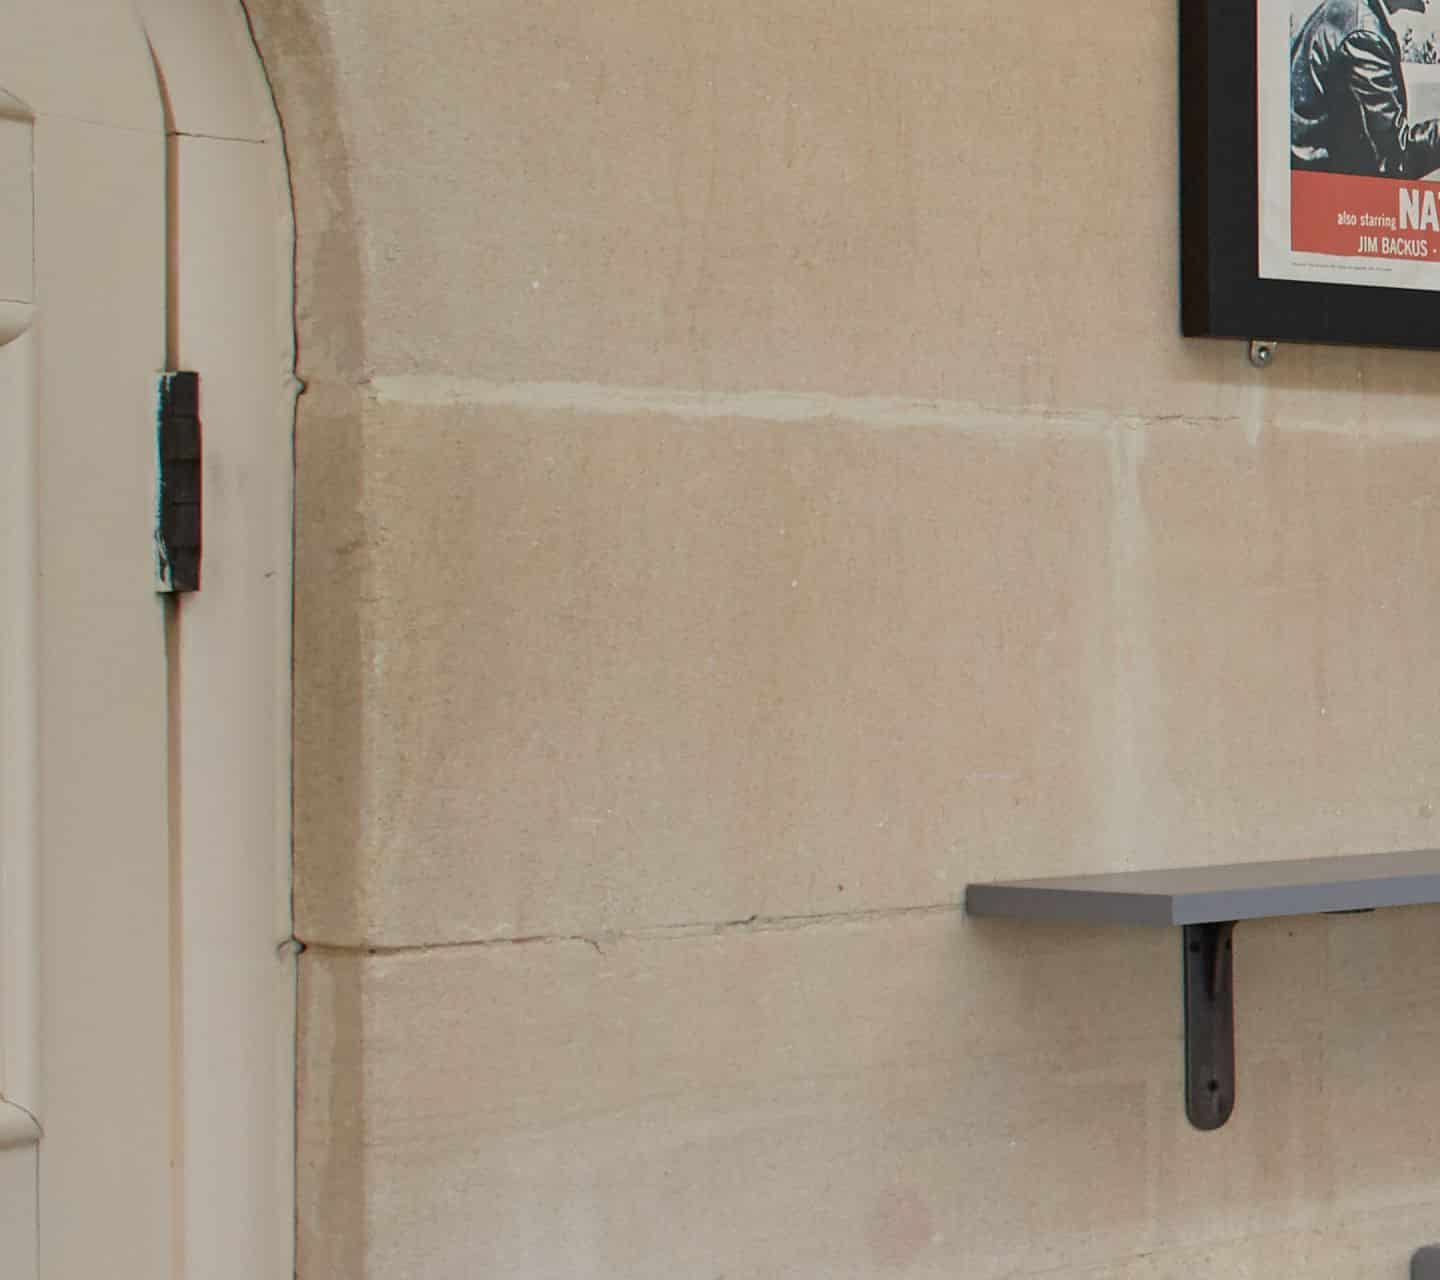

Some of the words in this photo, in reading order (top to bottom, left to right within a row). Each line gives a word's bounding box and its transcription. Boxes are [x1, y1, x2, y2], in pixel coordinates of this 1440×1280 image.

[1337, 210, 1357, 225] also
[1360, 213, 1397, 230] starring
[1357, 236, 1378, 253] JIM
[1381, 238, 1428, 257] BACKUS
